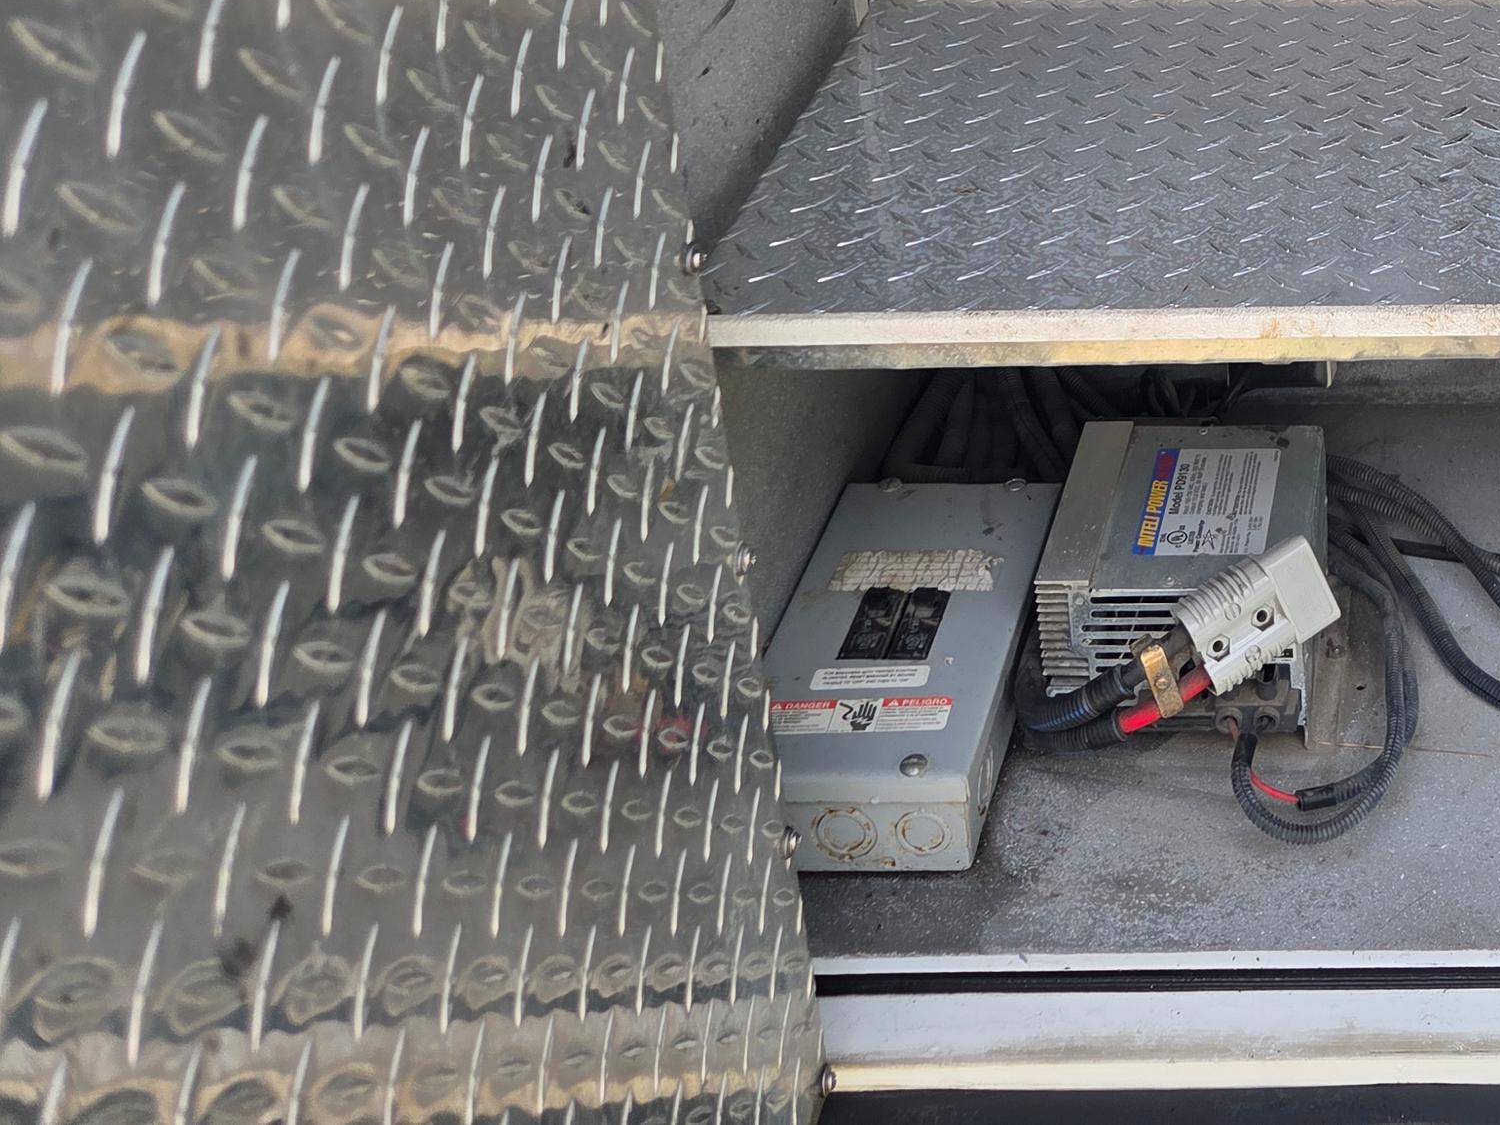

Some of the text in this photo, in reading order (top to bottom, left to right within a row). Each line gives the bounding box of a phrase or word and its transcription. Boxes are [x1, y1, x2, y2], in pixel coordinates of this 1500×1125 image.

[1146, 480, 1169, 514] POWER
[1168, 463, 1190, 515] Model PD9130
[1137, 515, 1160, 547] INTELI
[785, 701, 831, 709] DANGER
[902, 698, 948, 706] PELIGRO
